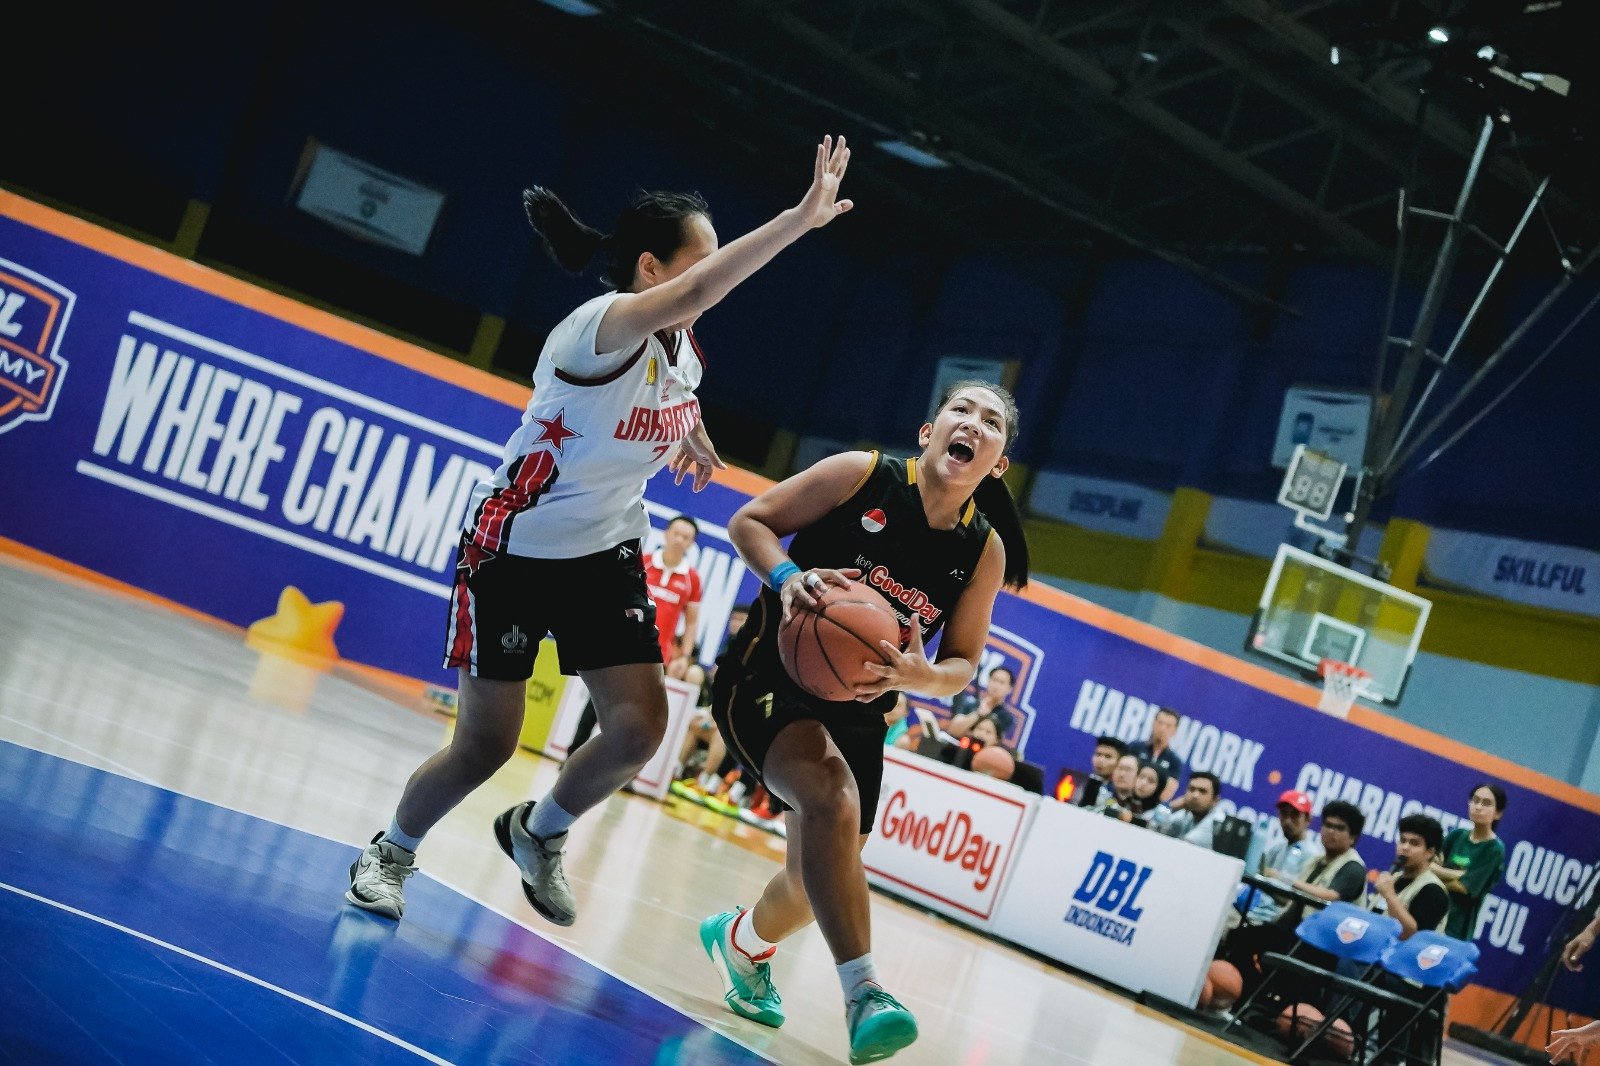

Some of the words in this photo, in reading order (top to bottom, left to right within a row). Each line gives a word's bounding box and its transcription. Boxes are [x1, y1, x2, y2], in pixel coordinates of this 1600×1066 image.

[0, 288, 26, 338] L
[93, 334, 304, 511] WHERE
[1493, 555, 1586, 594] SKILLFUL
[1070, 679, 1161, 743] HAR
[1072, 850, 1154, 923] DBL
[1064, 904, 1138, 946] INDONESIA
